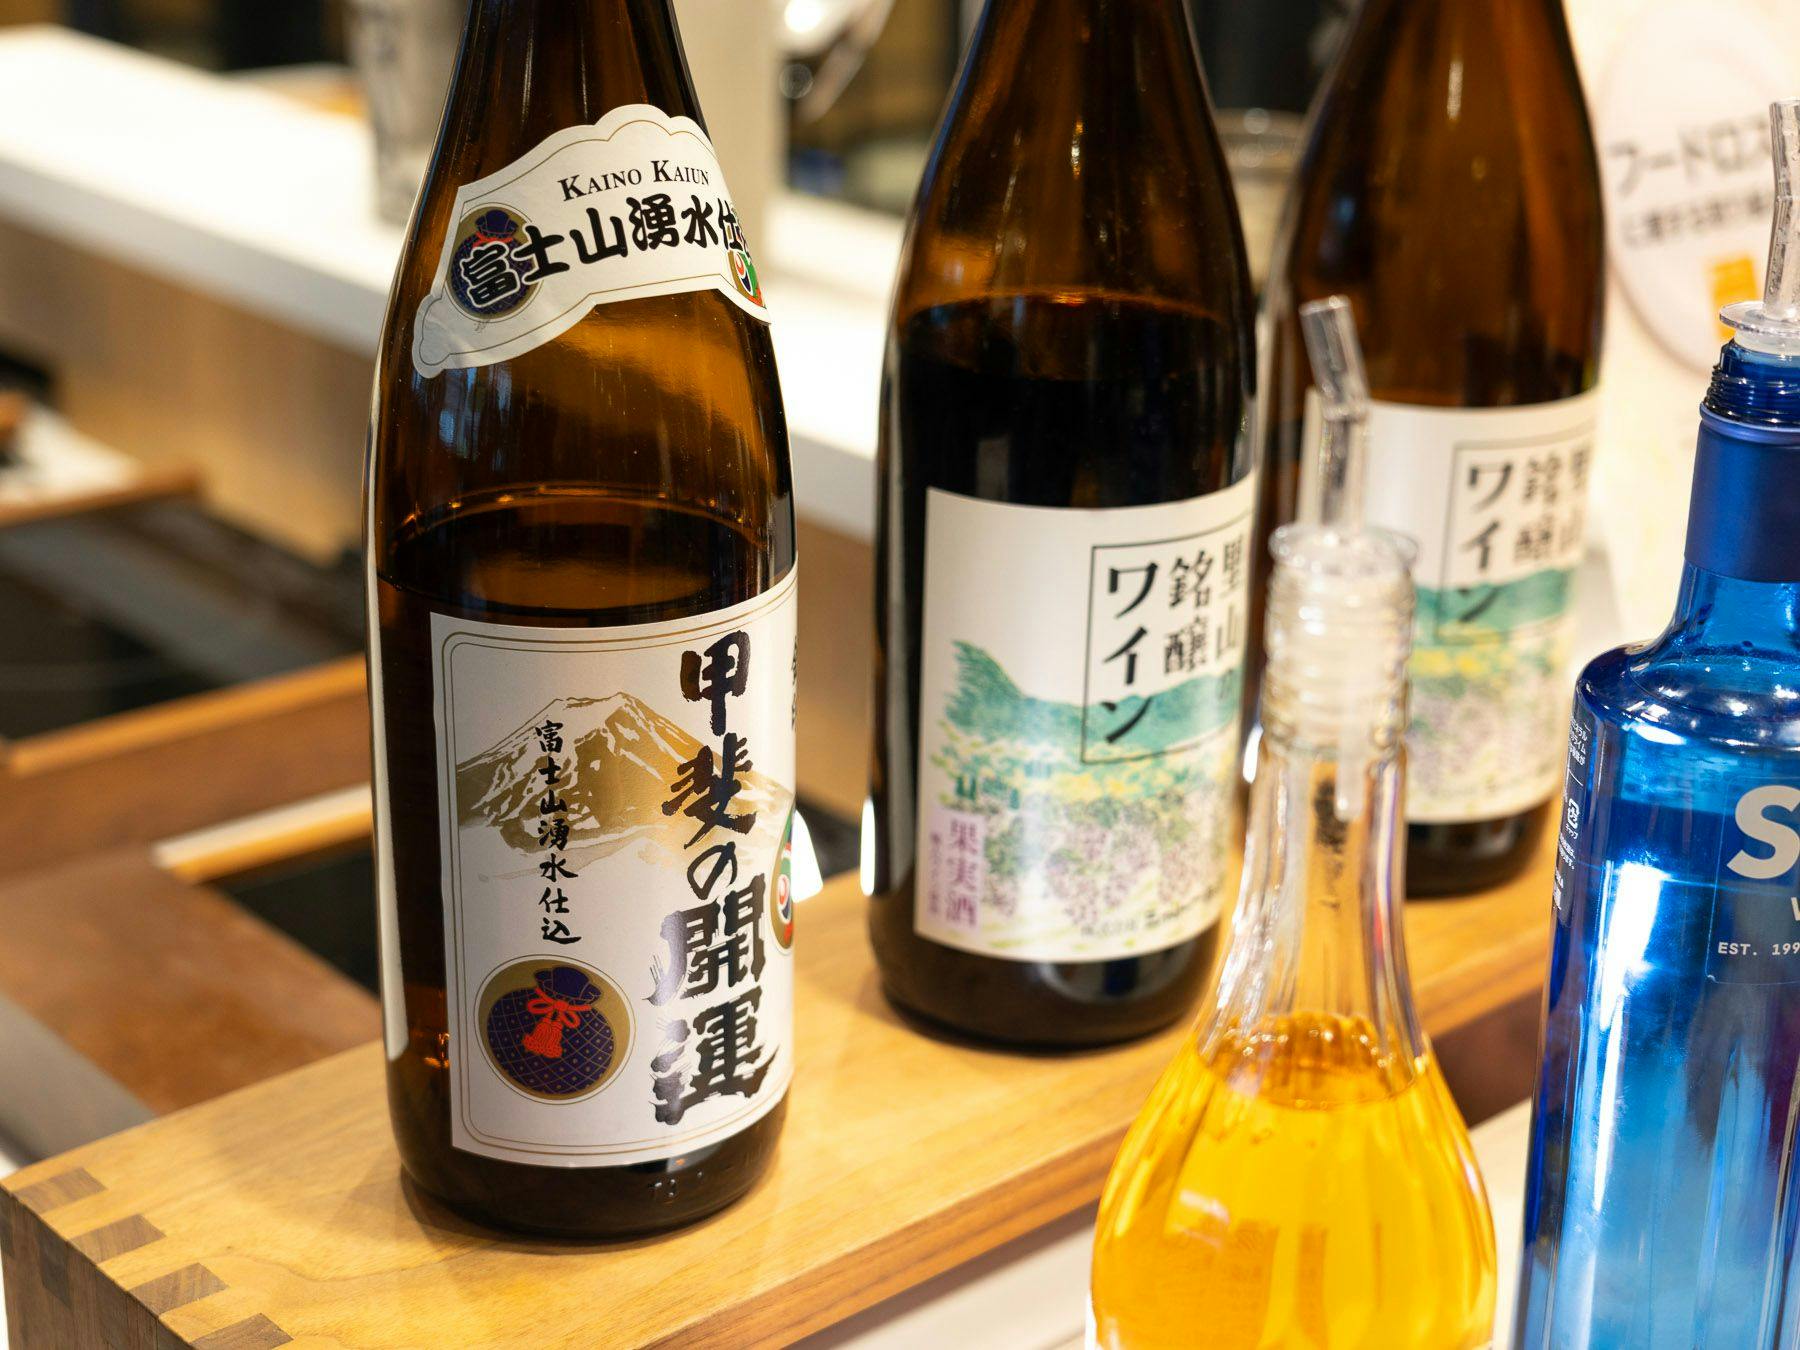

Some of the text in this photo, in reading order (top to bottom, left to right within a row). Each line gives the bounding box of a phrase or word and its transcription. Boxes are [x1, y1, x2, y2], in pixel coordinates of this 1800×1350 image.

[557, 159, 710, 202] KAINO KAIUN
[1101, 562, 1159, 743] ワイン
[534, 720, 582, 945] 富士山湧水仕込
[643, 629, 776, 1126] 甲斐の開運
[1718, 941, 1757, 956] EST.
